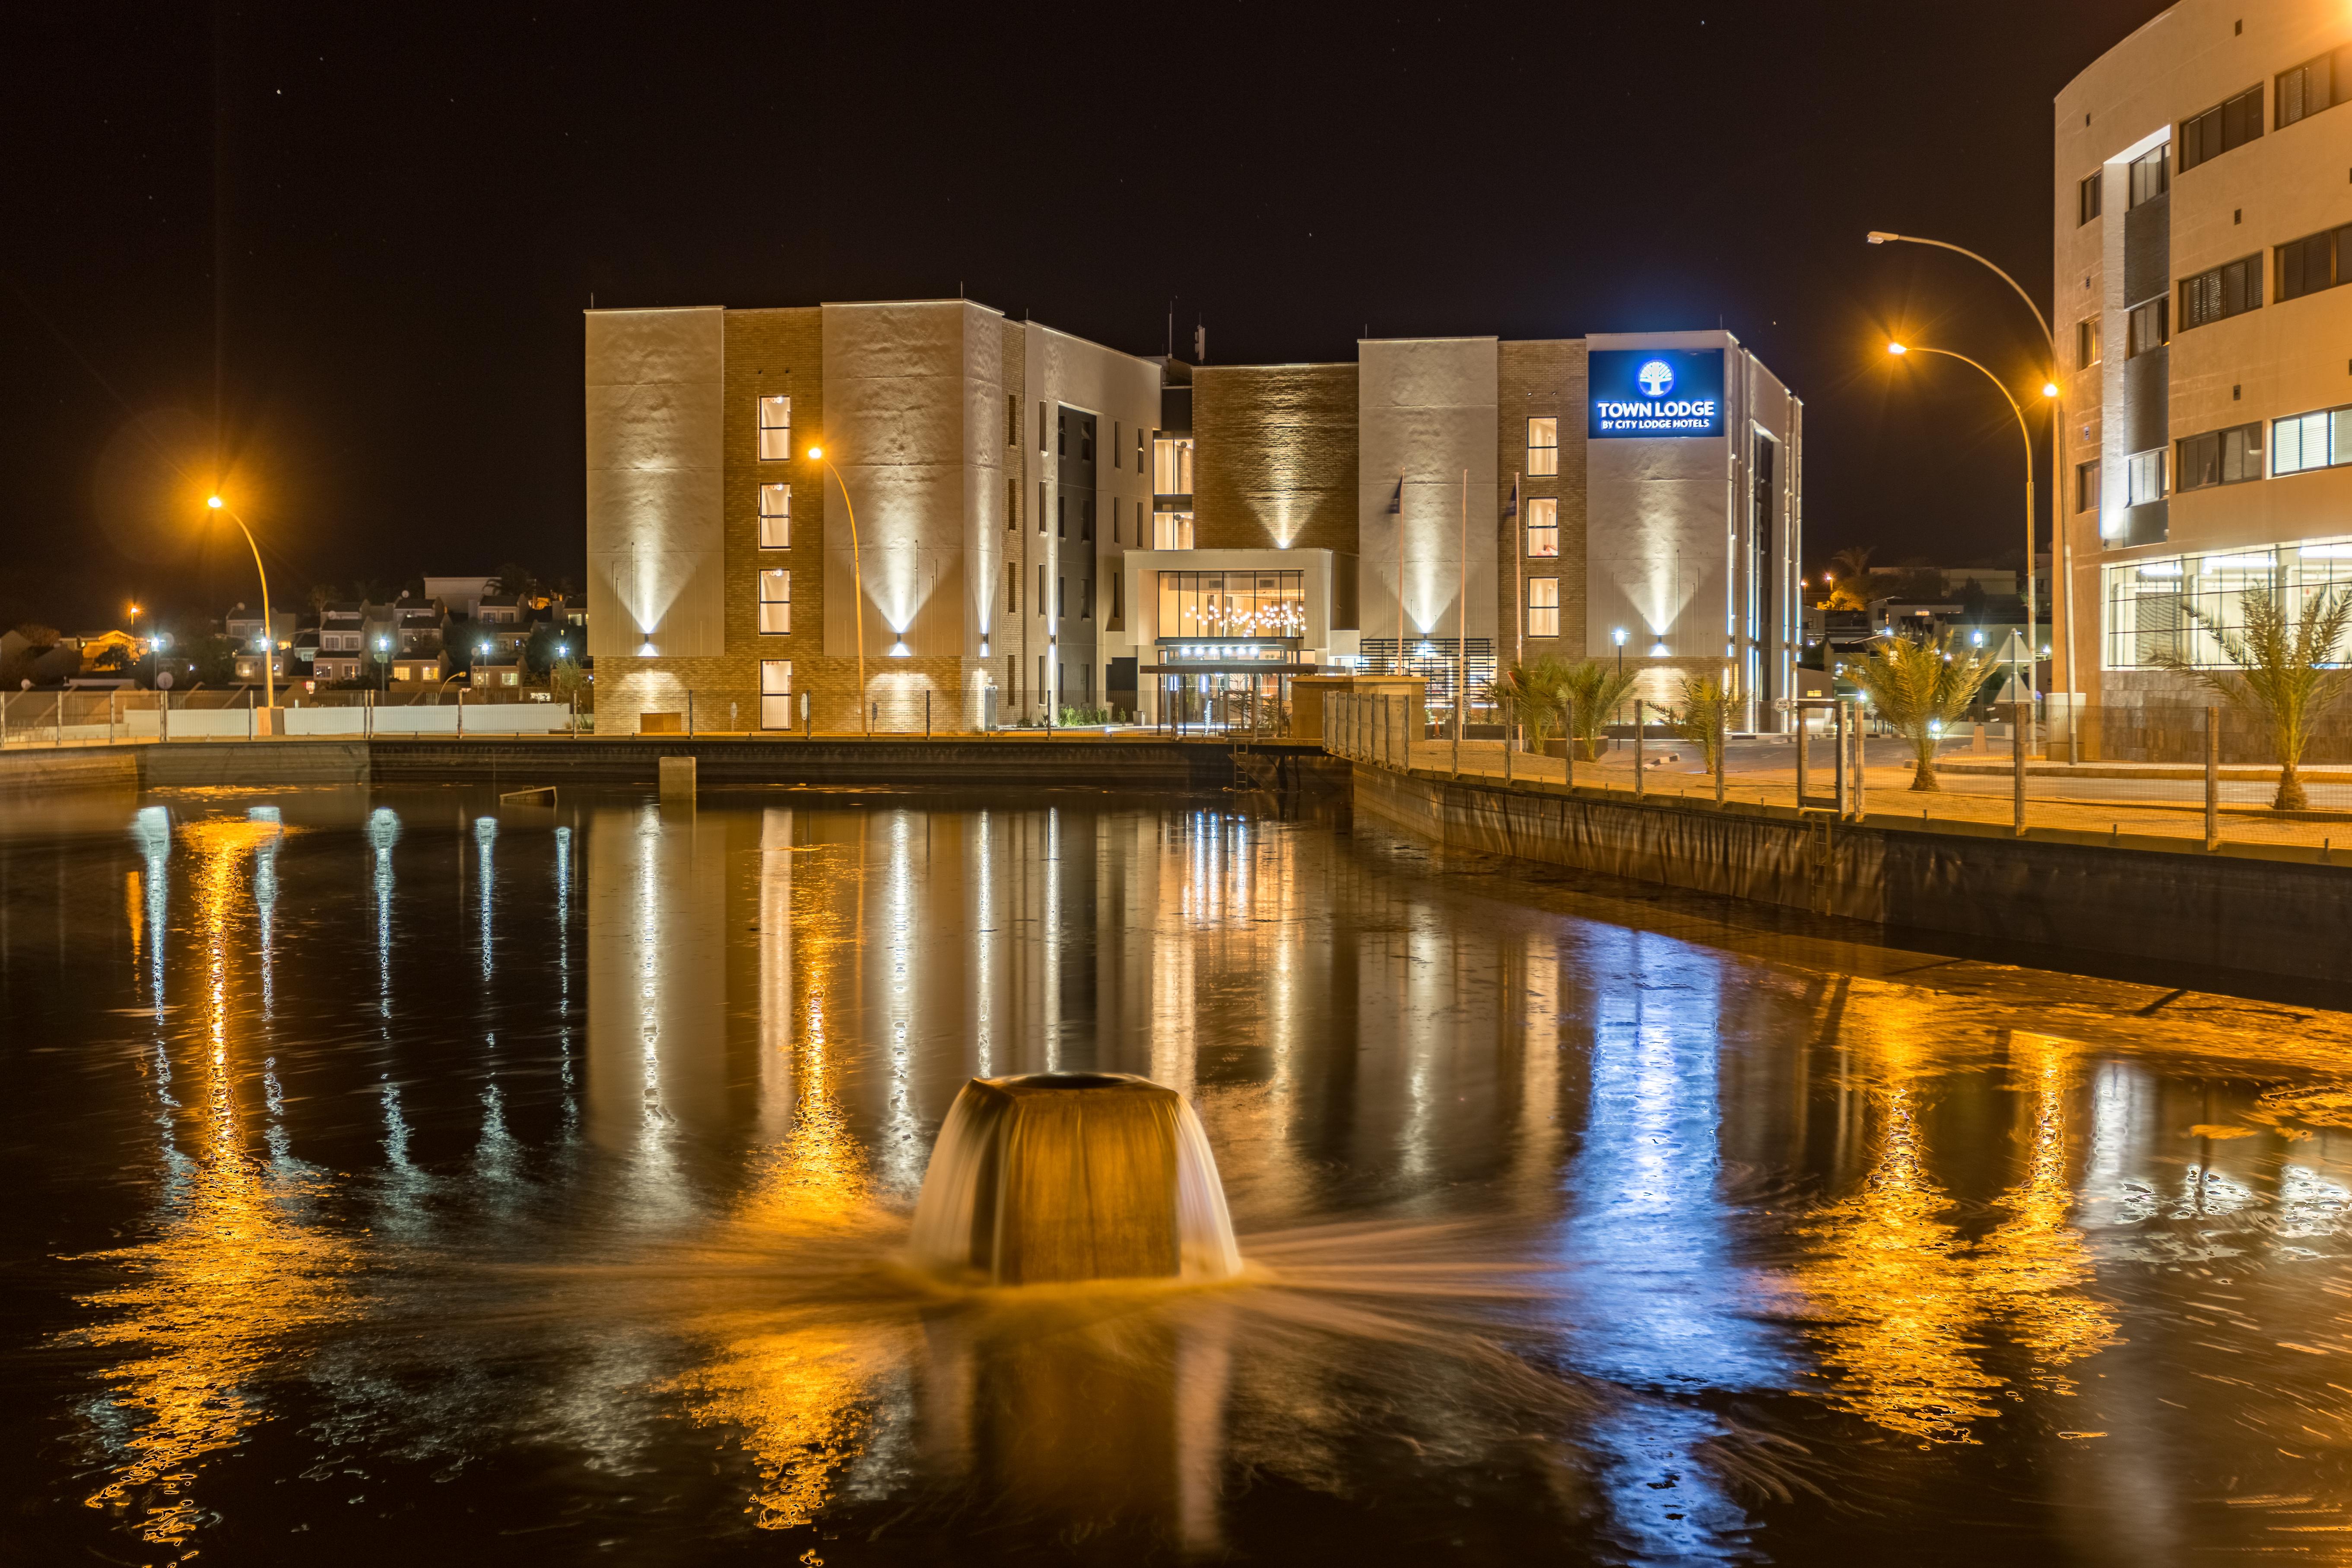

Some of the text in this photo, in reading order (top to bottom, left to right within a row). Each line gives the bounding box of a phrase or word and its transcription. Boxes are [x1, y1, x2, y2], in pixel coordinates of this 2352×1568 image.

[1598, 401, 1714, 418] TOWN LODGE
[1602, 419, 1710, 429] BY CITY LODGE HOTELS
